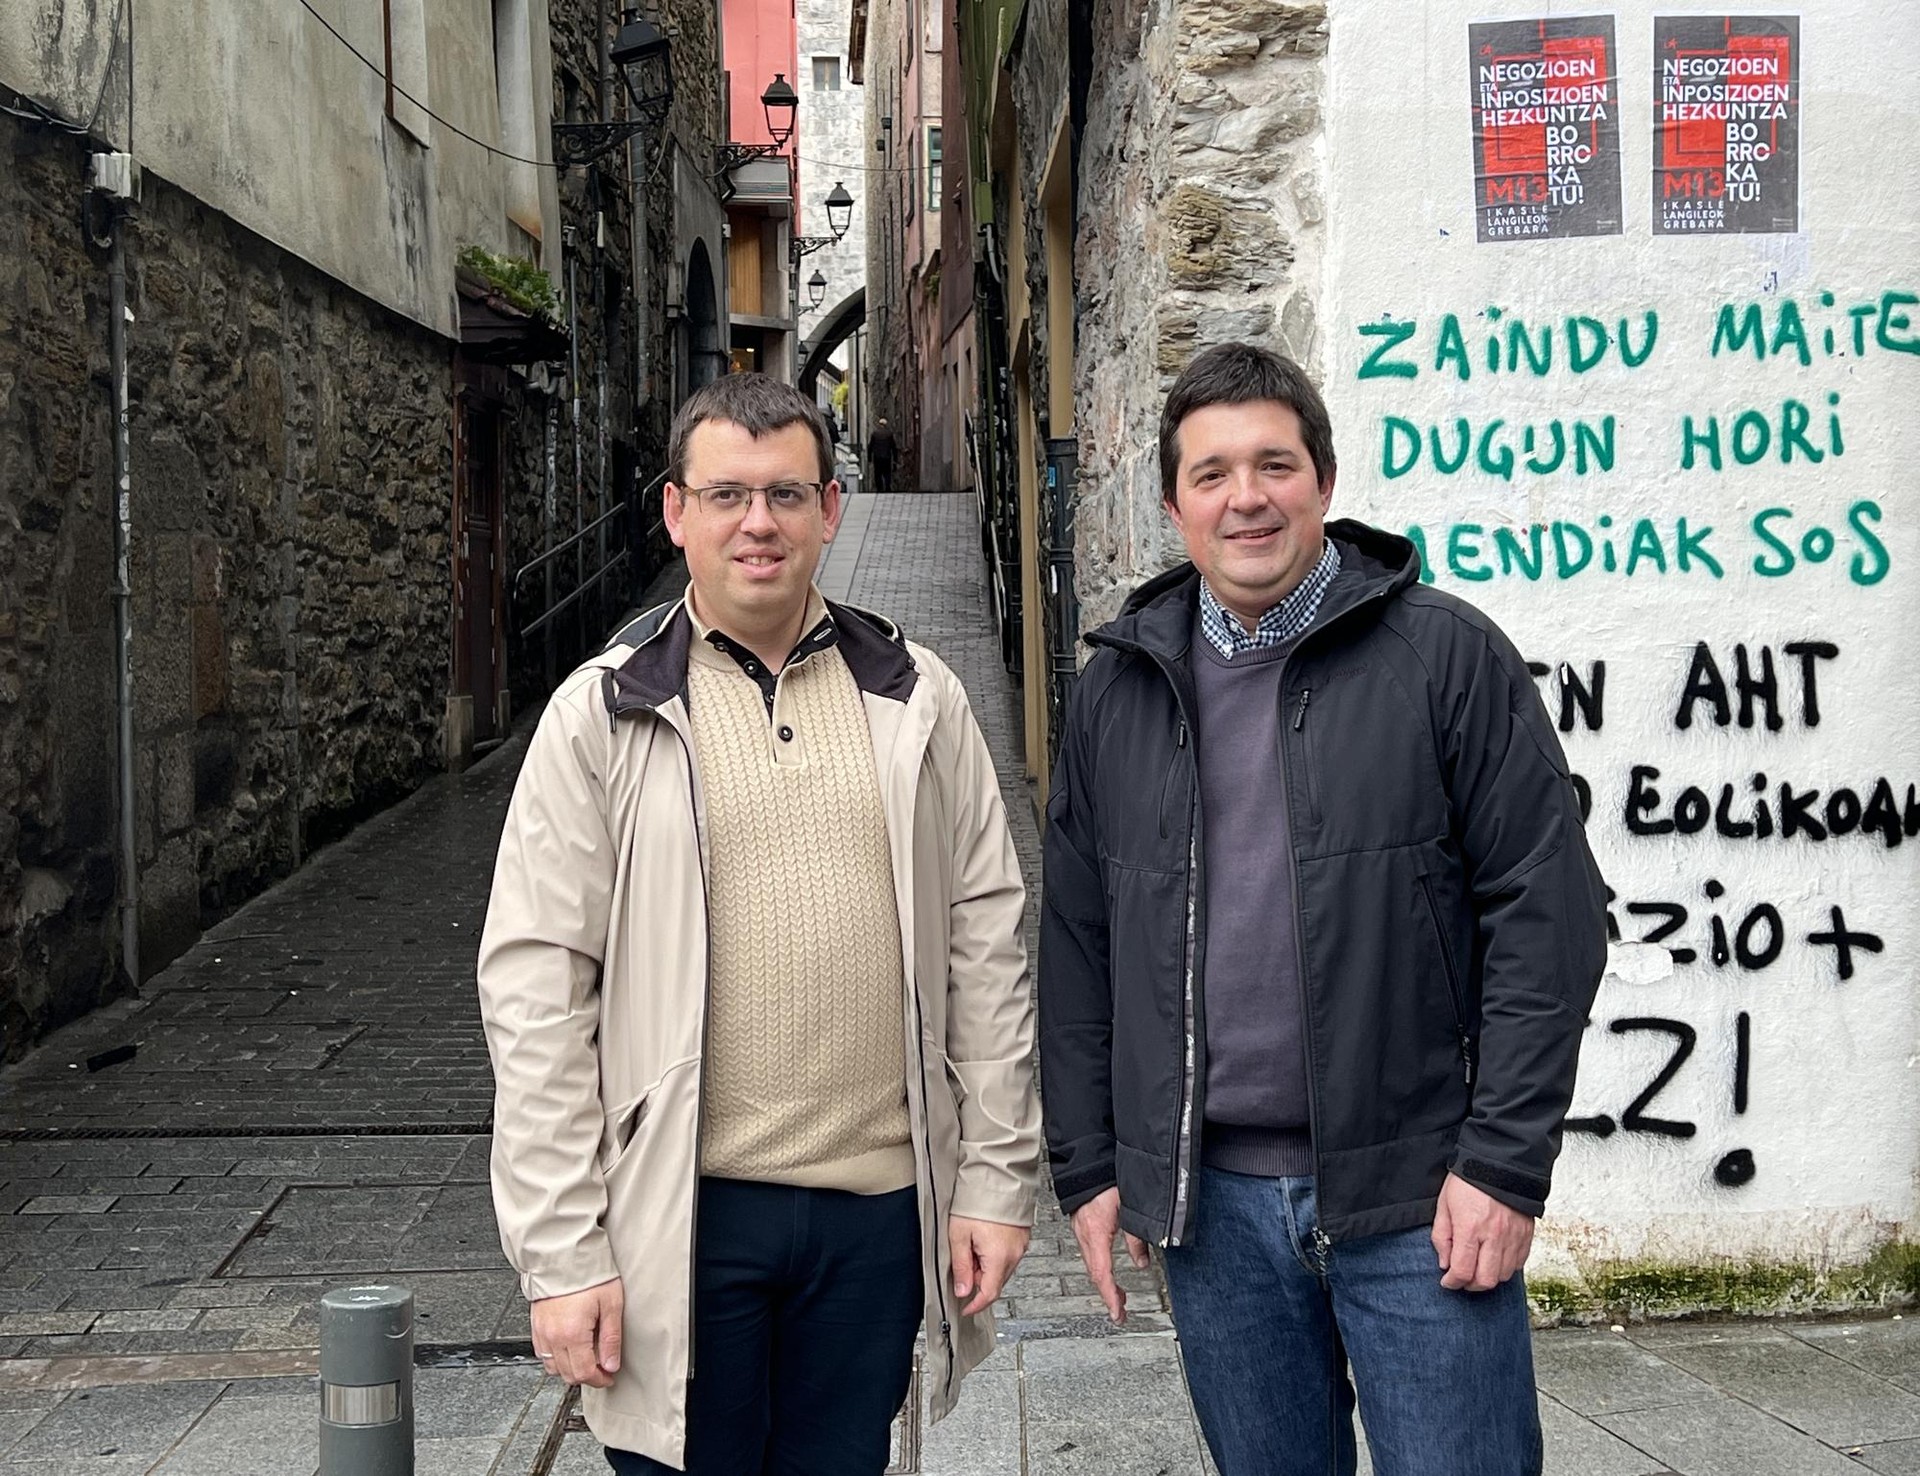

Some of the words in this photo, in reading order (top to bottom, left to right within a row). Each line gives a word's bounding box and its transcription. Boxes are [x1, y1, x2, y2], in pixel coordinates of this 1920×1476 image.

[1480, 59, 1596, 83] NEGOZIOEN
[1663, 58, 1778, 76] NEGOZIOEN
[1480, 82, 1497, 93] ETA
[1662, 76, 1680, 86] ETA
[1481, 84, 1608, 109] INPOSIZIOEN
[1663, 84, 1789, 103] INPOSIZIOEN
[1482, 104, 1607, 128] HEZKUNTZA
[1663, 102, 1787, 121] HEZKUNTZA
[1546, 125, 1578, 146] BO
[1726, 122, 1758, 142] BO
[1548, 165, 1581, 186] KA
[1726, 162, 1758, 182] KA
[1486, 176, 1548, 205] M13
[1663, 171, 1725, 199] M13
[1725, 182, 1761, 202] TU!
[1548, 185, 1585, 206] TU!
[1663, 201, 1724, 210] IKASLE
[1487, 206, 1548, 217] IKASLE
[1487, 215, 1548, 227] LANGILEOK
[1663, 210, 1724, 219] LANGILEOK
[1488, 224, 1549, 236] GREBARA
[1663, 219, 1724, 229] GREBARA
[1382, 414, 1616, 482] DUGUN
[1524, 660, 1605, 732] N
[1675, 640, 1839, 731] AHT
